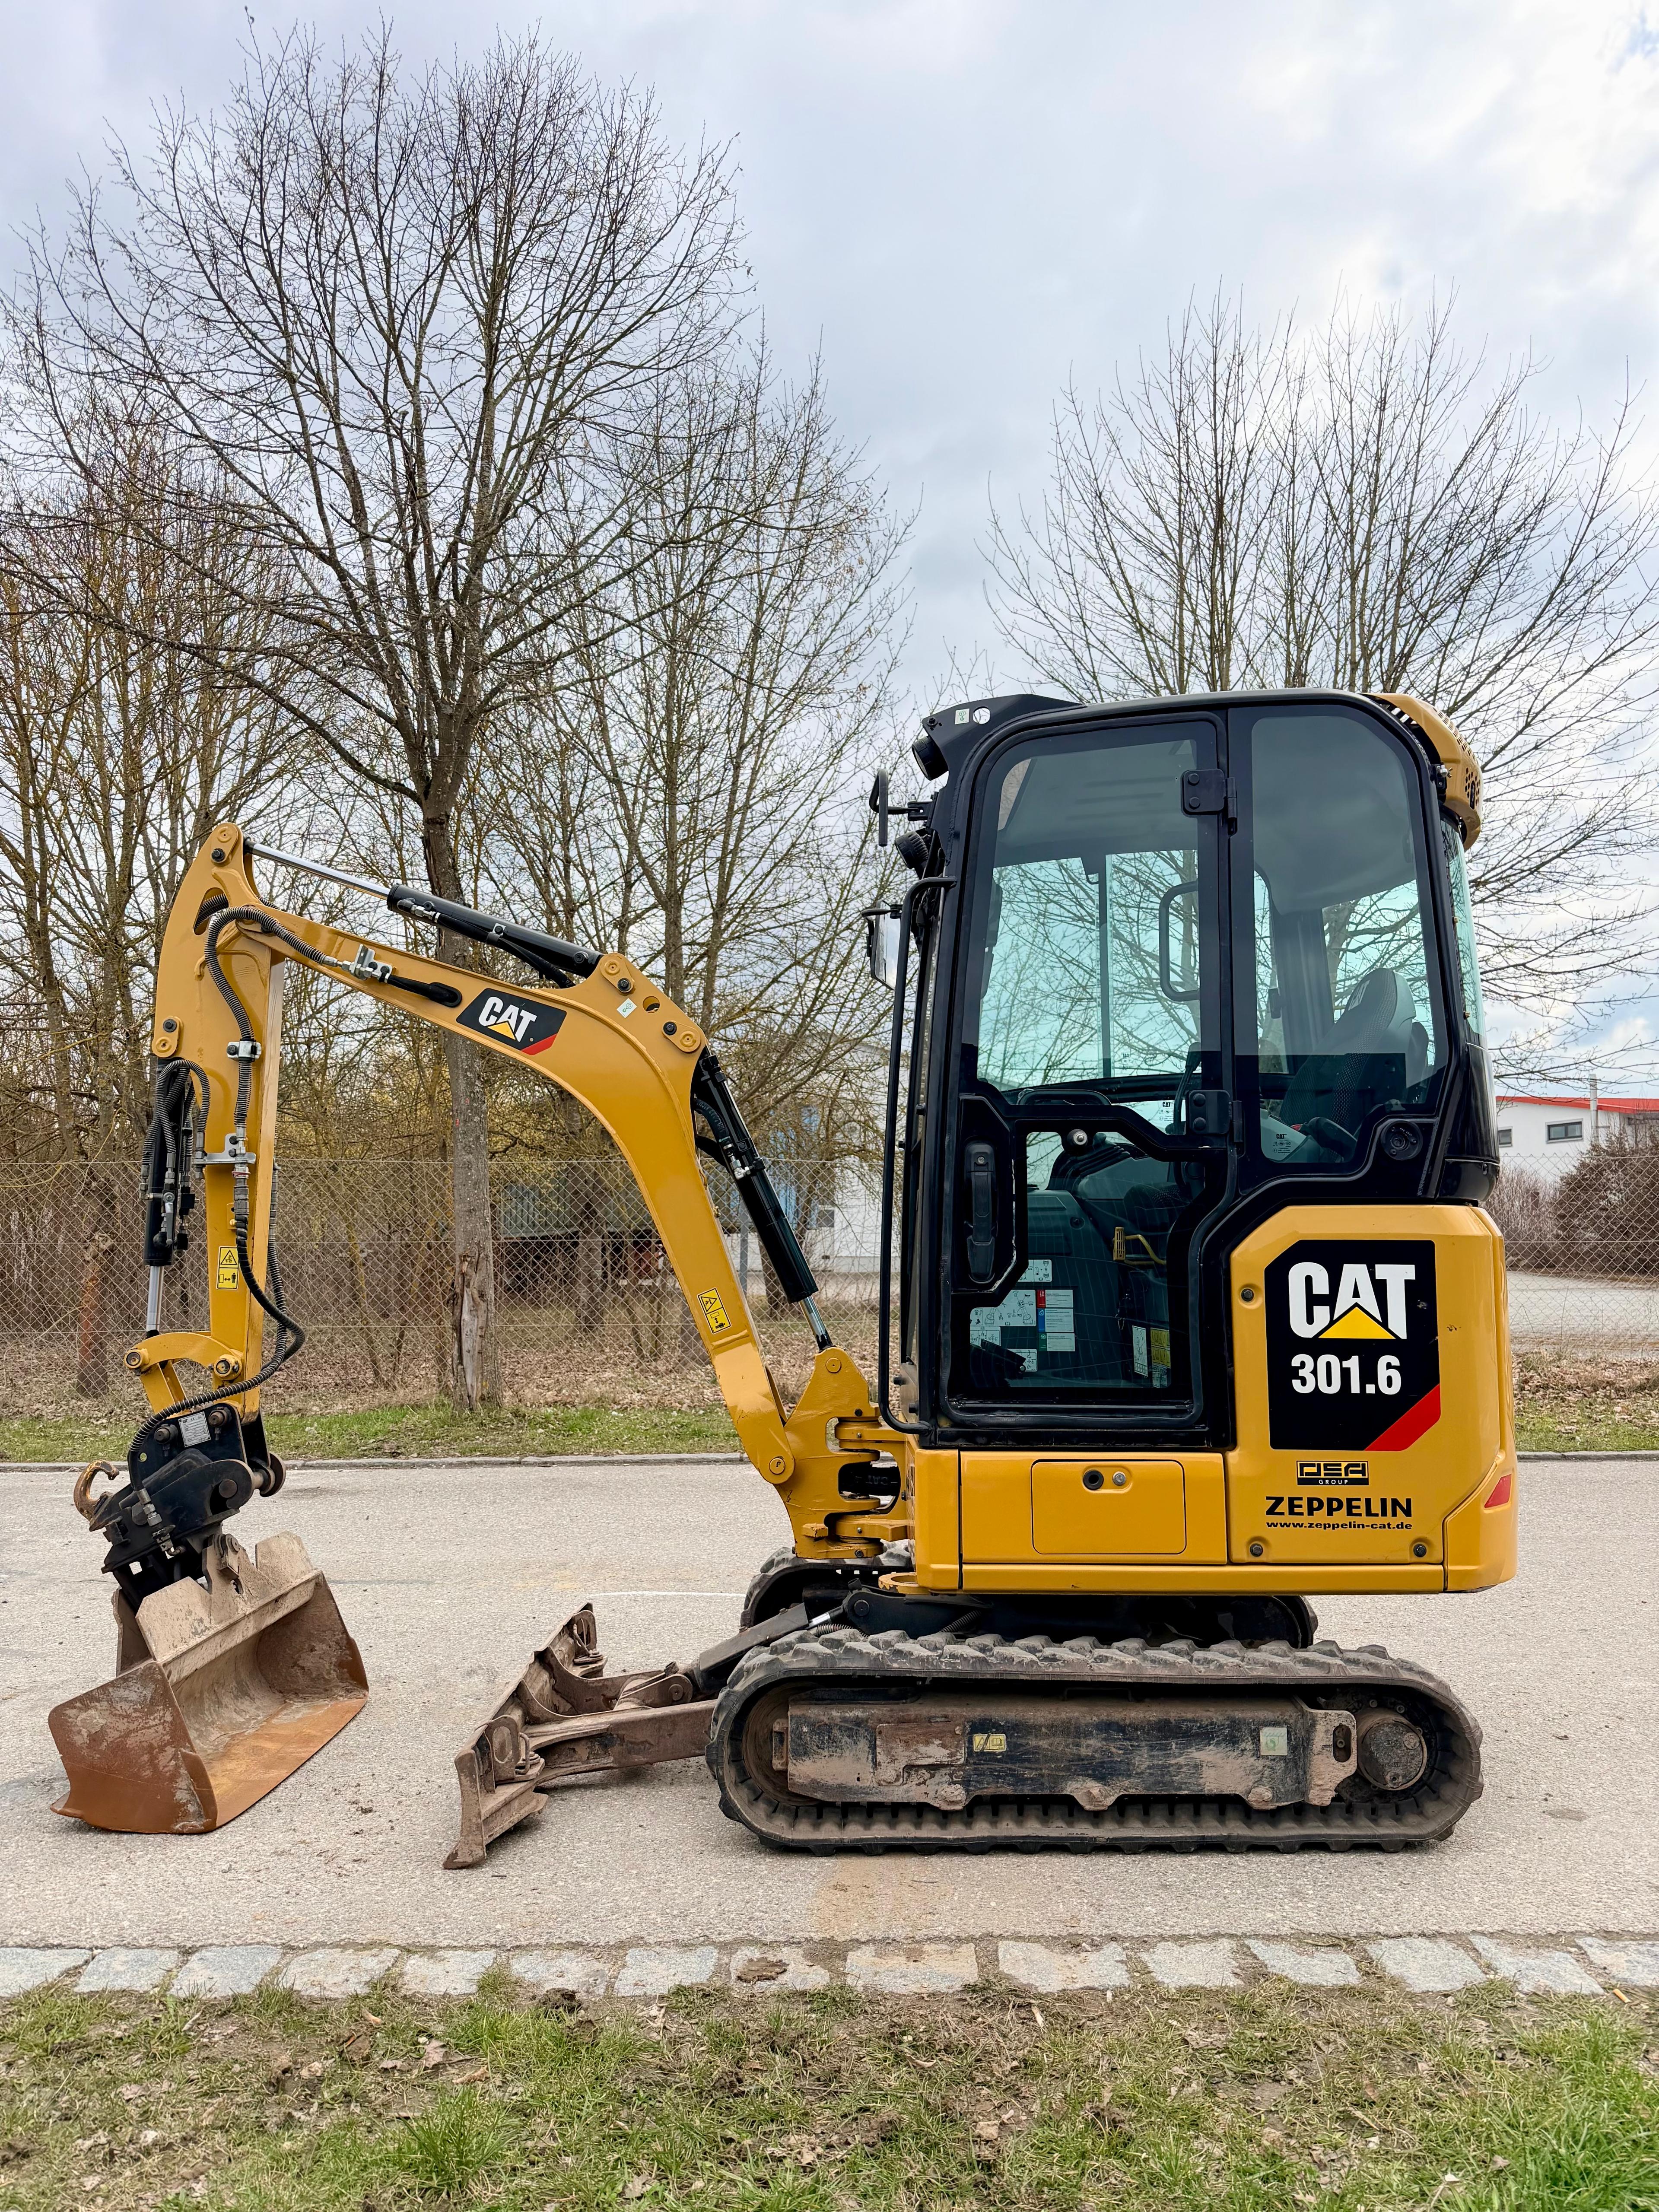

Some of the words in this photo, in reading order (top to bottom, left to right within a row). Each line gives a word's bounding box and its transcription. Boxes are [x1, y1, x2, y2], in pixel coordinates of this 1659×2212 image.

[478, 996, 537, 1042] CAT
[1288, 1262, 1416, 1339] CAT
[1291, 1354, 1402, 1395] 301.6
[1265, 1496, 1412, 1517] ZEPPELIN
[1266, 1521, 1412, 1530] www.zeppelin-cat.de
